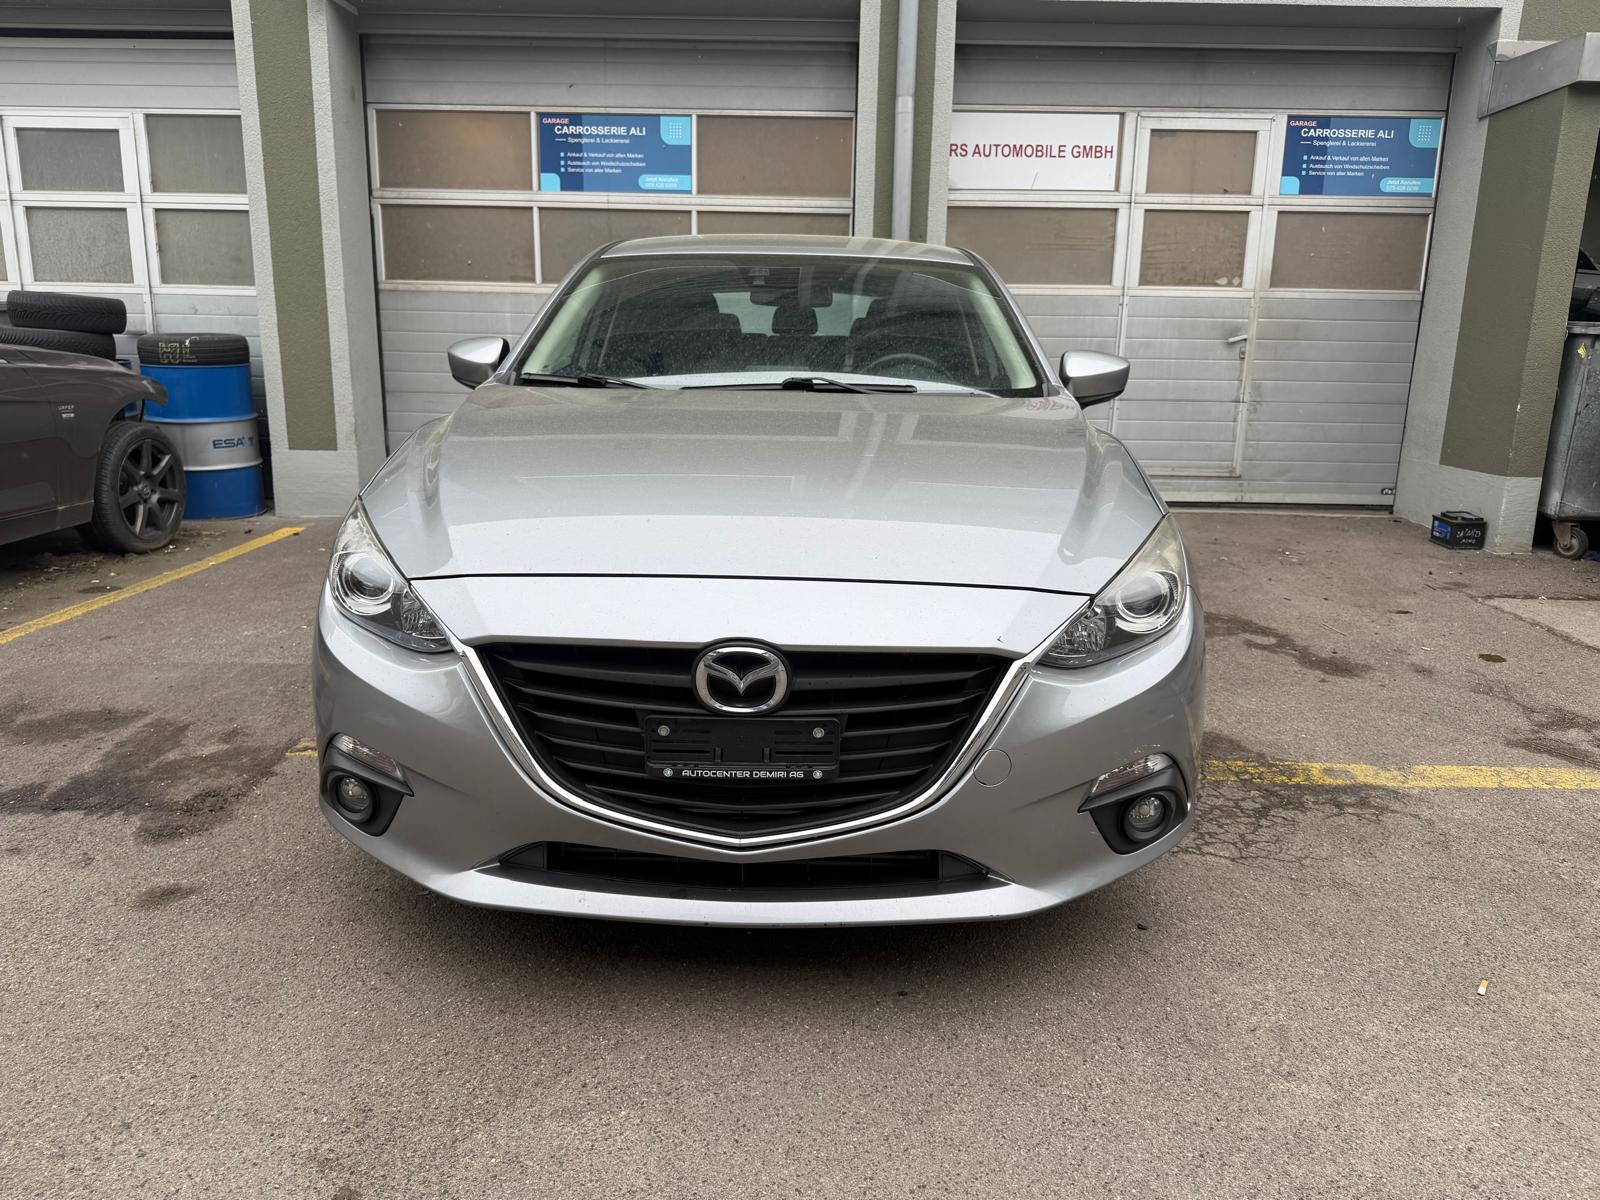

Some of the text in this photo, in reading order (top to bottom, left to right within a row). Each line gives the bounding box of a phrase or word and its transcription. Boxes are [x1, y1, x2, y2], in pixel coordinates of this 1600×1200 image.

[554, 126, 646, 136] CARROSSERIE ALI
[1301, 128, 1394, 138] CARROSSERIE ALI
[949, 144, 1114, 158] RS AUTOMOBILE GMBH
[682, 770, 750, 778] AUTOCENTER
